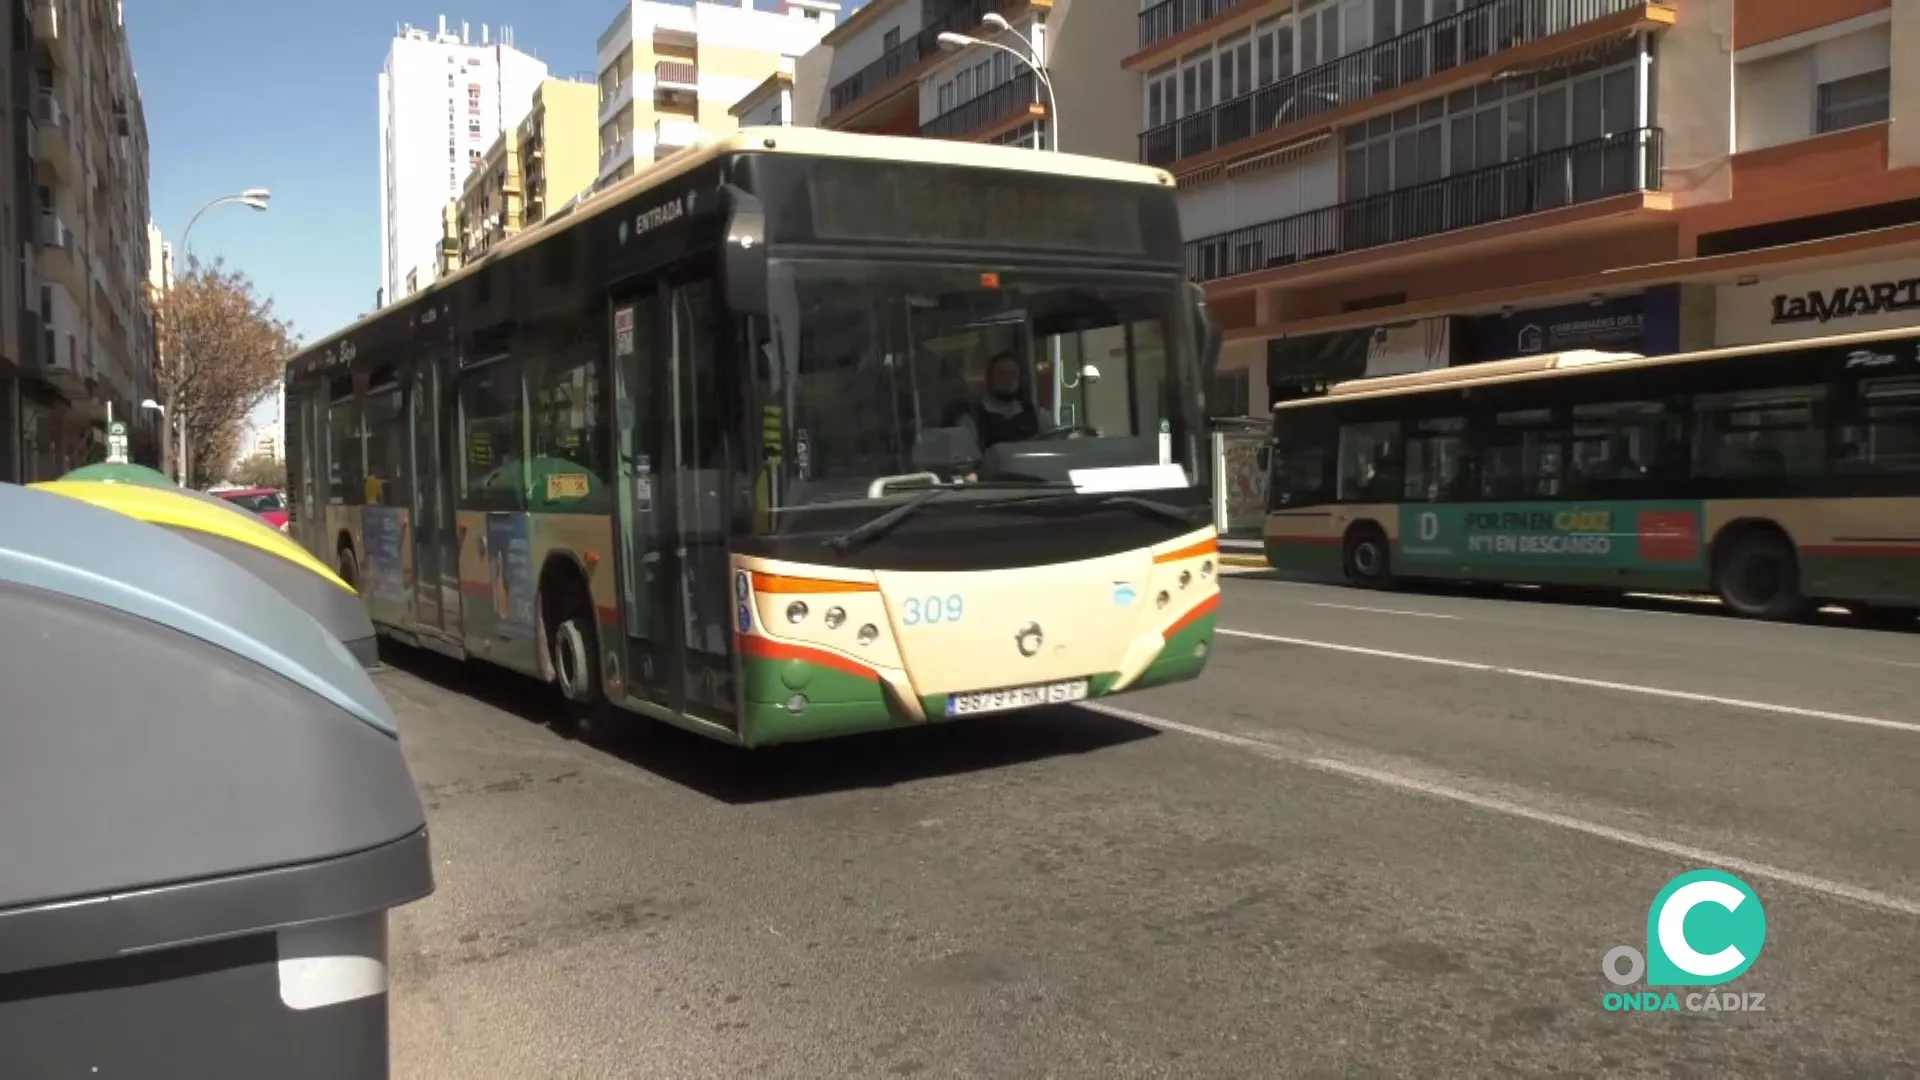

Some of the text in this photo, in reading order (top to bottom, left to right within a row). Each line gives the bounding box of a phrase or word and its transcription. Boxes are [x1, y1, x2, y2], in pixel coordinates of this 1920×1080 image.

[636, 197, 685, 235] ENTRADA
[1518, 534, 1611, 554] DESCANSO
[901, 593, 964, 626] 309
